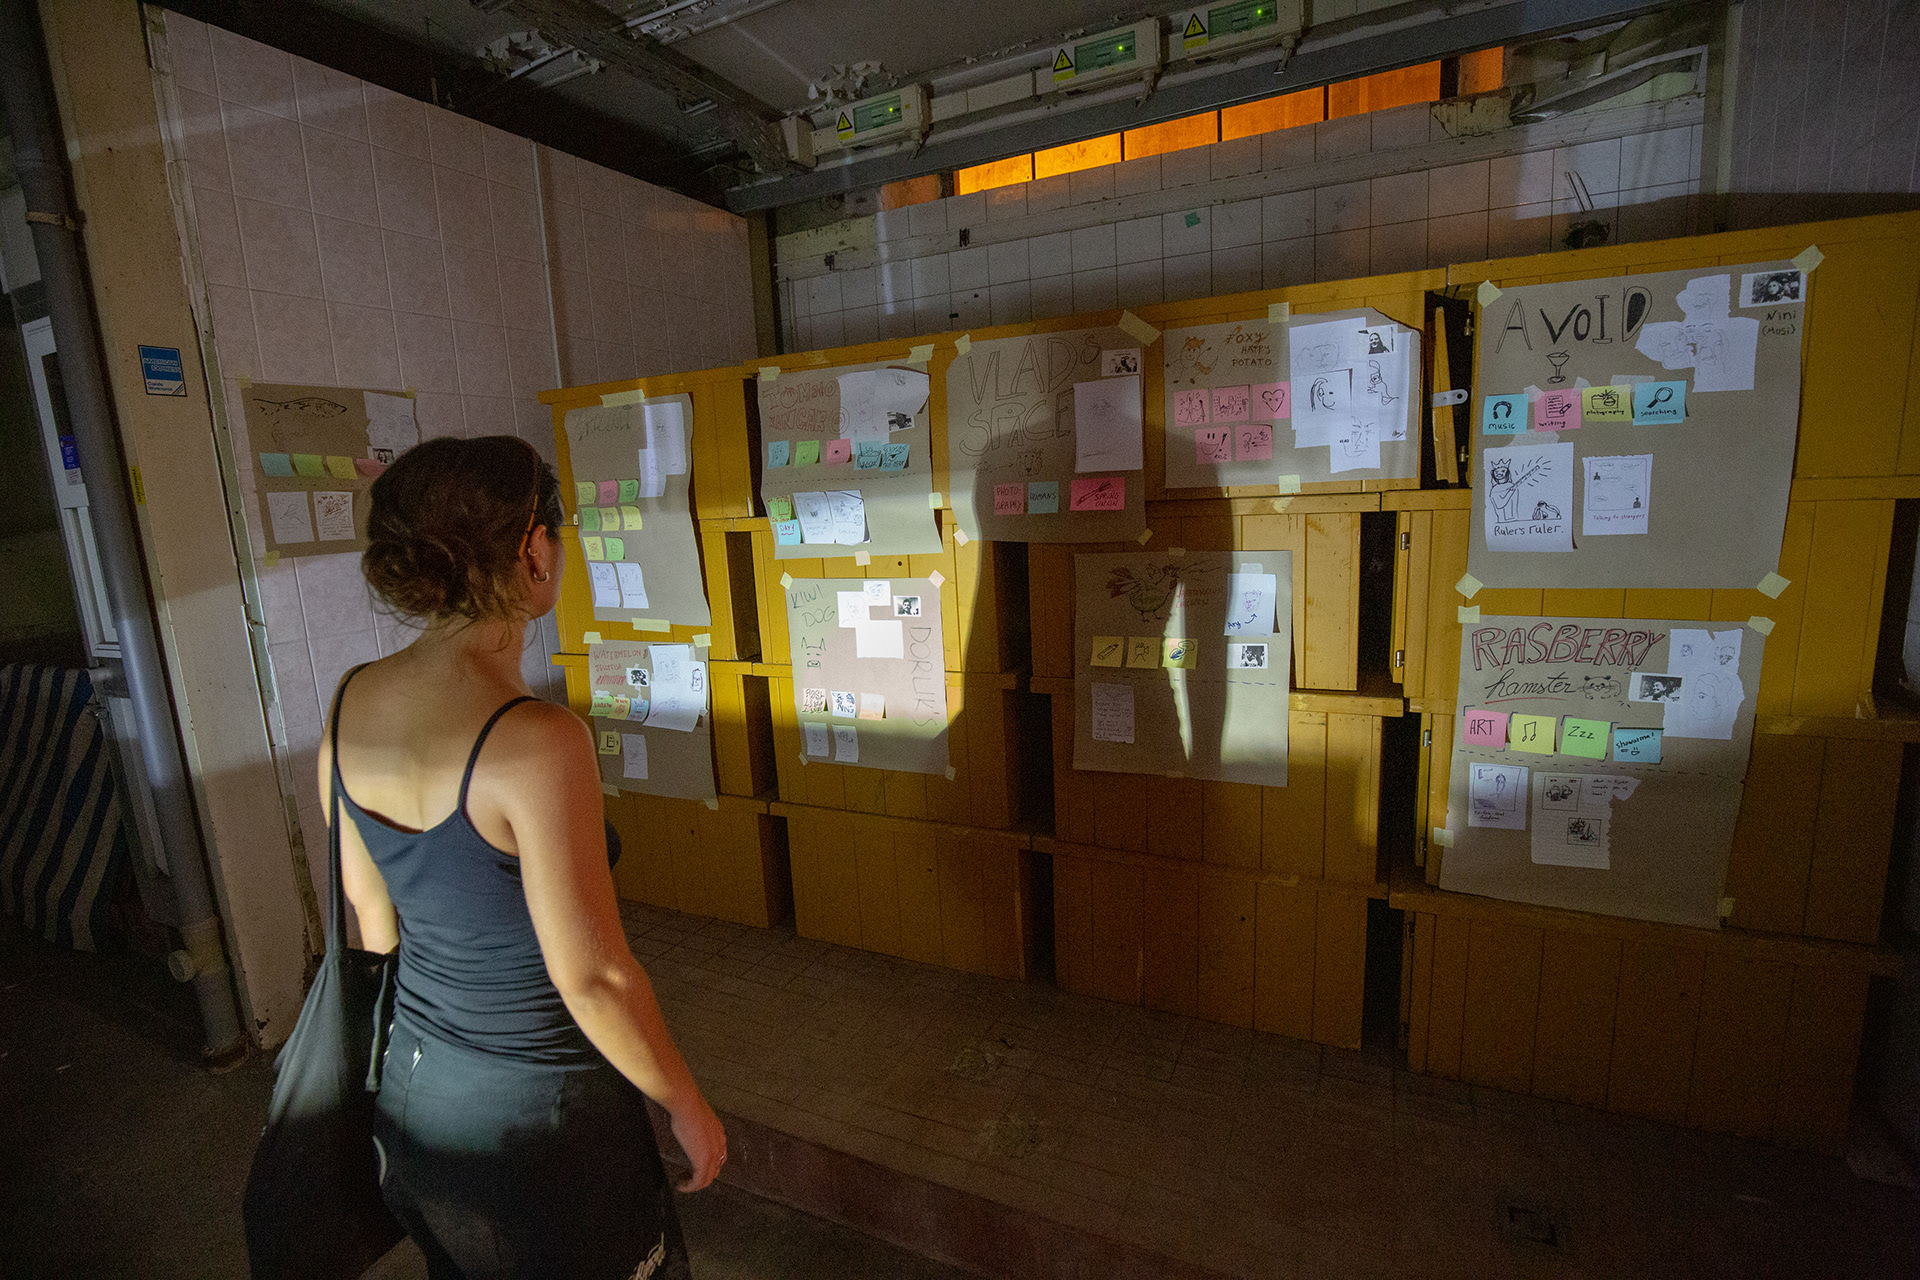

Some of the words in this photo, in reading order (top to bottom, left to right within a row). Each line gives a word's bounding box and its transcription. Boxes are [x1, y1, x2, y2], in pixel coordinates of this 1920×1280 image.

[1495, 285, 1653, 354] AVOID
[1766, 309, 1796, 321] Nini
[1241, 344, 1271, 355] HAPPY
[1232, 358, 1272, 367] POTATO
[959, 388, 1074, 457] SPACE
[1488, 422, 1515, 430] music
[1538, 421, 1566, 429] writing
[1494, 525, 1526, 536] Ruler's
[790, 583, 824, 609] KIWI
[802, 606, 835, 627] DOG
[1472, 622, 1666, 672] RASBERRY
[593, 649, 641, 661] WATERMELON
[1484, 668, 1576, 699] hamster
[1470, 719, 1495, 736] ART
